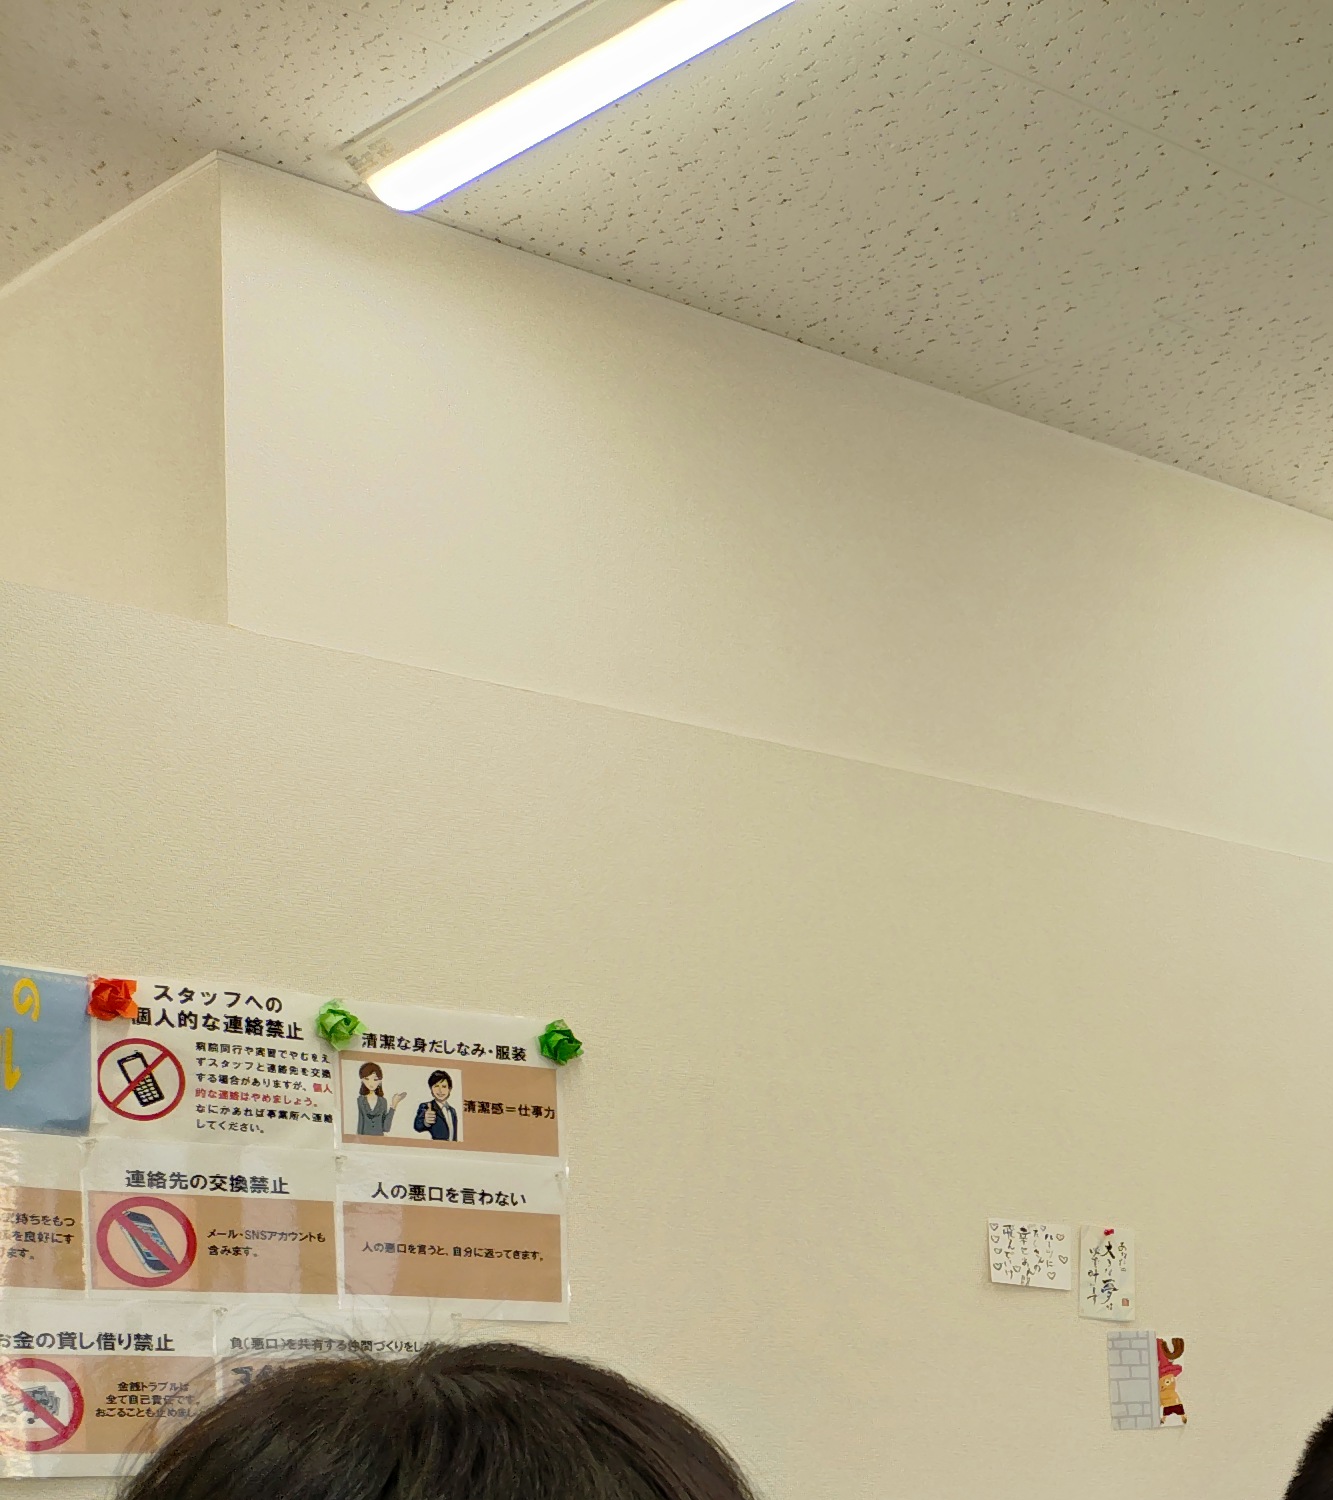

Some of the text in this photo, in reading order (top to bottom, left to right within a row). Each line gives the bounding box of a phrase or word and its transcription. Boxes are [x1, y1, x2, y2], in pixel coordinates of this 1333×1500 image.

[153, 984, 283, 1014] スタッフへの
[361, 1032, 527, 1062] 清潔な身だしなみ・服装
[196, 1119, 265, 1135] してください。
[125, 1169, 290, 1195] 連絡先の交換禁止
[371, 1181, 527, 1206] 人の悪口を言わない
[2, 1212, 76, 1227] 持ちをもつ
[2, 1231, 75, 1245] を良好にす
